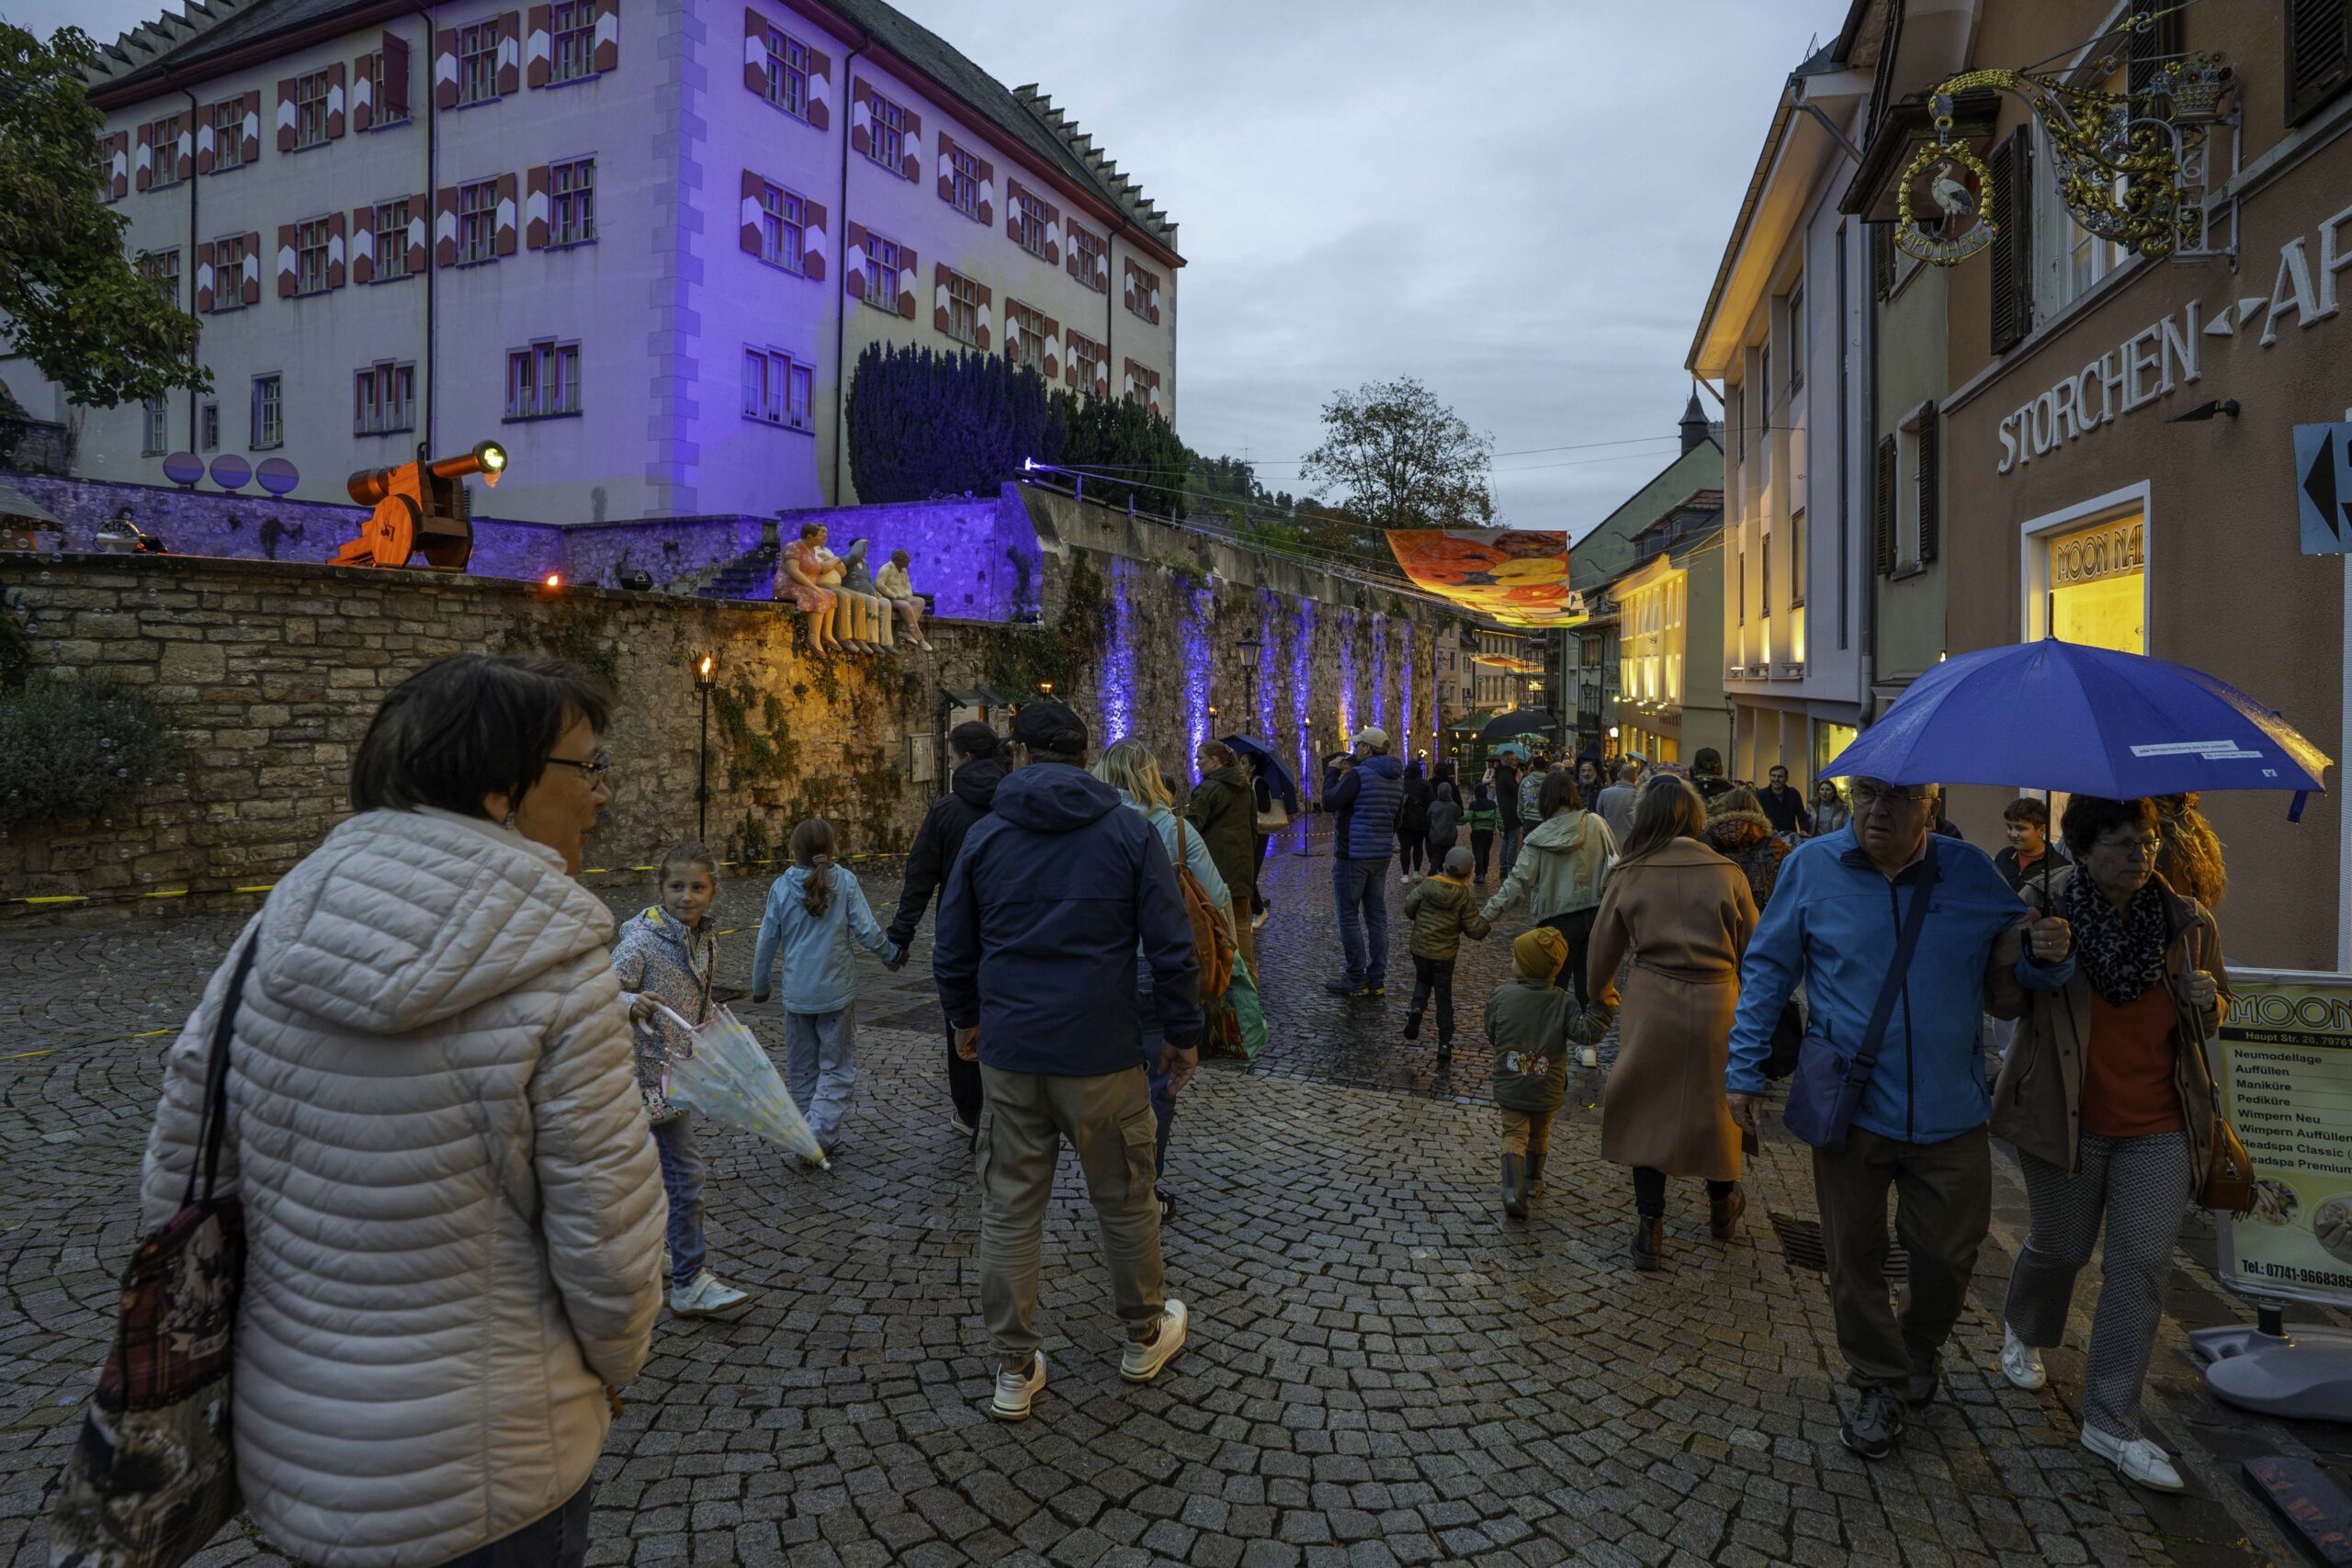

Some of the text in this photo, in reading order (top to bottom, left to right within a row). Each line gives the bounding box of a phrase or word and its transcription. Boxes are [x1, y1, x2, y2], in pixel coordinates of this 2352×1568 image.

[1998, 299, 2202, 476] STORCHEN
[2058, 533, 2109, 582] MOON
[2228, 994, 2352, 1030] MOON
[2245, 1031, 2278, 1043] Haupt
[2280, 1033, 2299, 1043] Str.
[2234, 1049, 2322, 1066] Neumodellage
[2235, 1065, 2290, 1076] Auffüllen
[2236, 1079, 2291, 1091] Maniküre
[2237, 1094, 2290, 1106] Pediküre
[2238, 1109, 2321, 1124] Wimpern Neu
[2239, 1123, 2352, 1143] Wimpern Auffüllen
[2241, 1139, 2293, 1153] Headspa
[2297, 1144, 2344, 1157] Classic
[2251, 1156, 2294, 1168] eadspa
[2242, 1259, 2264, 1275] Tel.:
